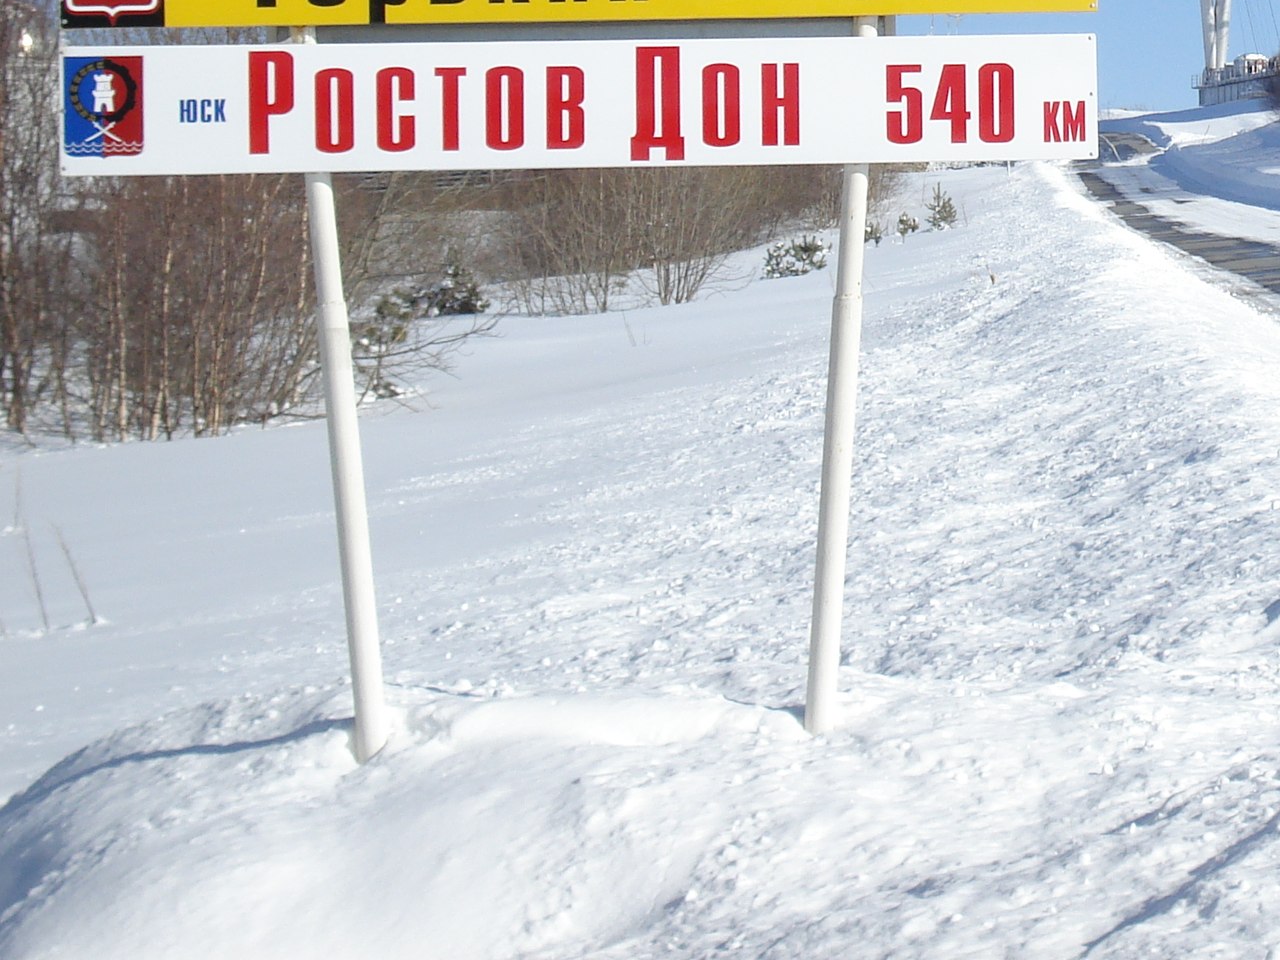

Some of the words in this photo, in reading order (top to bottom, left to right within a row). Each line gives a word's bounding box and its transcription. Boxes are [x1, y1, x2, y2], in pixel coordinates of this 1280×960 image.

[248, 50, 586, 155] Ростов
[630, 46, 800, 161] Дон
[886, 63, 1015, 144] 540
